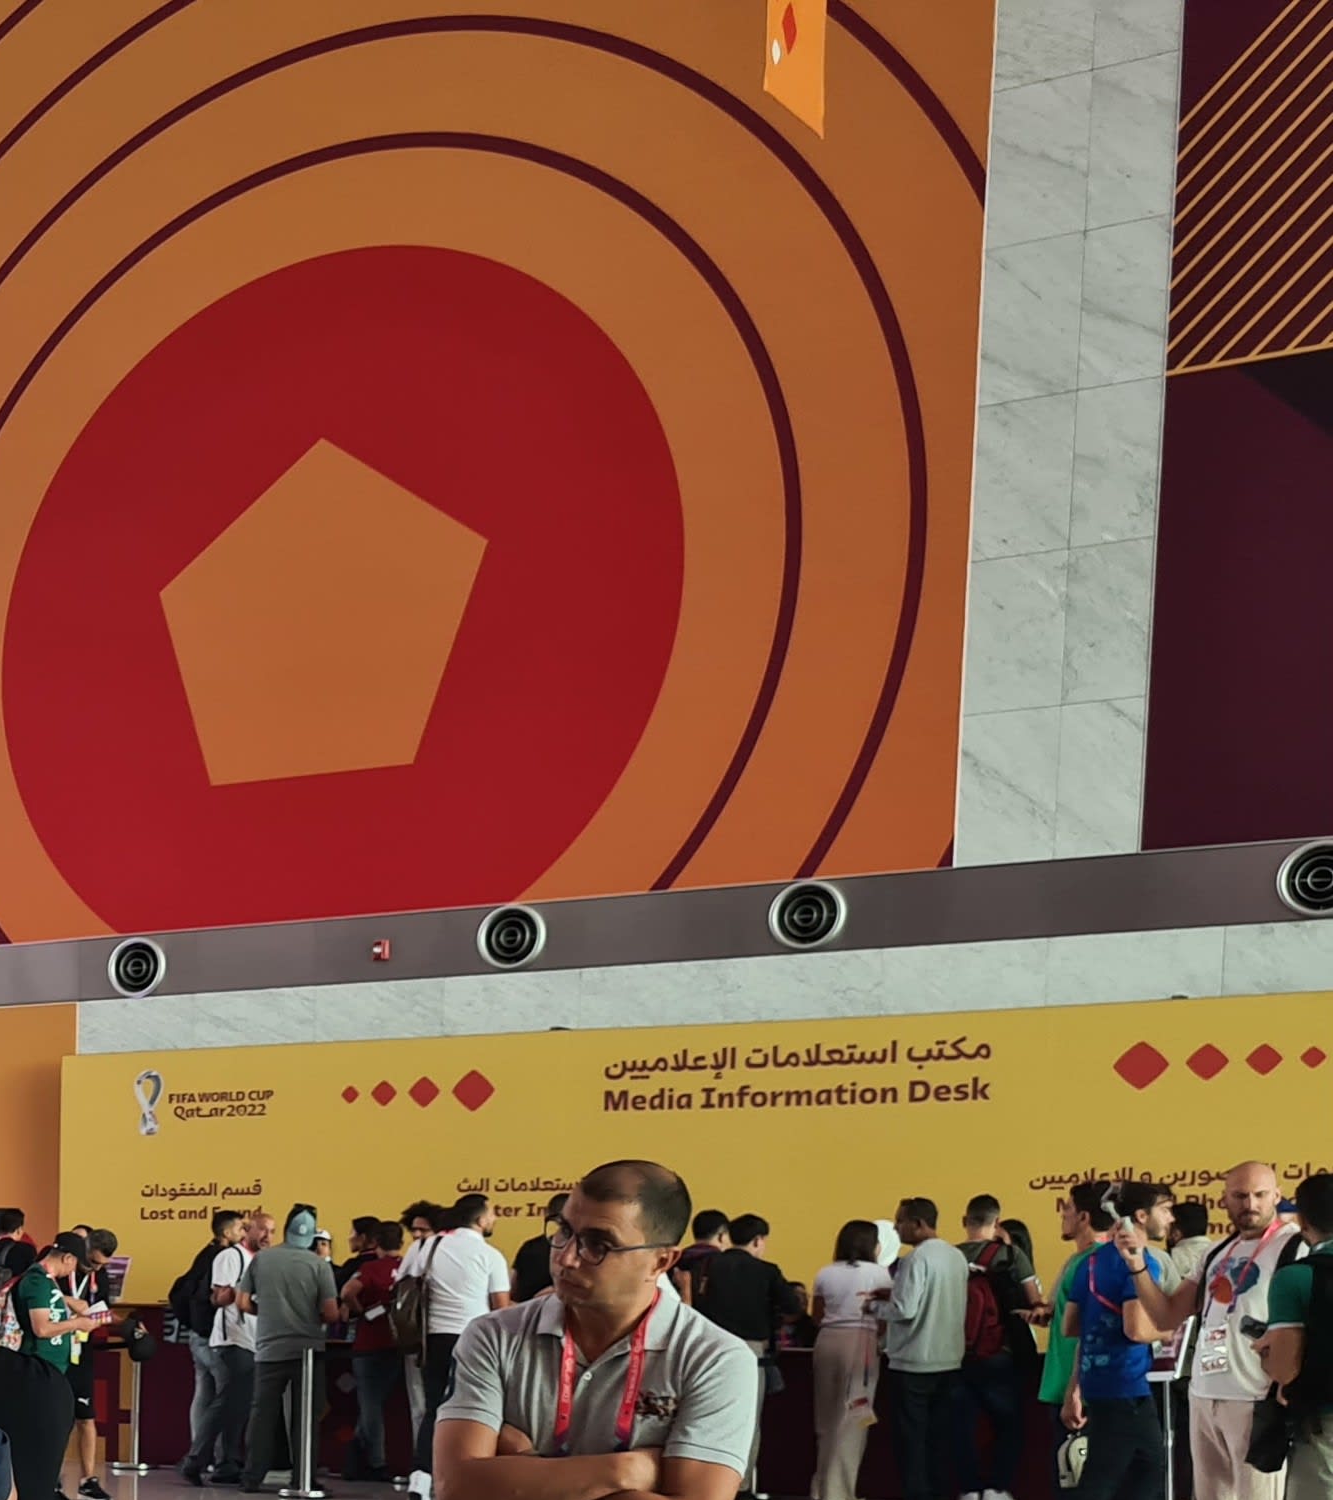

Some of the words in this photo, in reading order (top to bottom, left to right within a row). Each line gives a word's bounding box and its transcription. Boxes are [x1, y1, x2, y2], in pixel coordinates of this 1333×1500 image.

[604, 1047, 737, 1080] الإعلاميين
[744, 1040, 898, 1071] استعلامات
[906, 1036, 992, 1069] مكتب
[168, 1092, 196, 1104] FIFA
[247, 1090, 274, 1101] CUP
[603, 1088, 693, 1111] Media
[700, 1081, 899, 1109] Information
[907, 1077, 990, 1104] Desk
[221, 1179, 262, 1199] قسم
[140, 1207, 175, 1220] Lost
[178, 1206, 207, 1220] and
